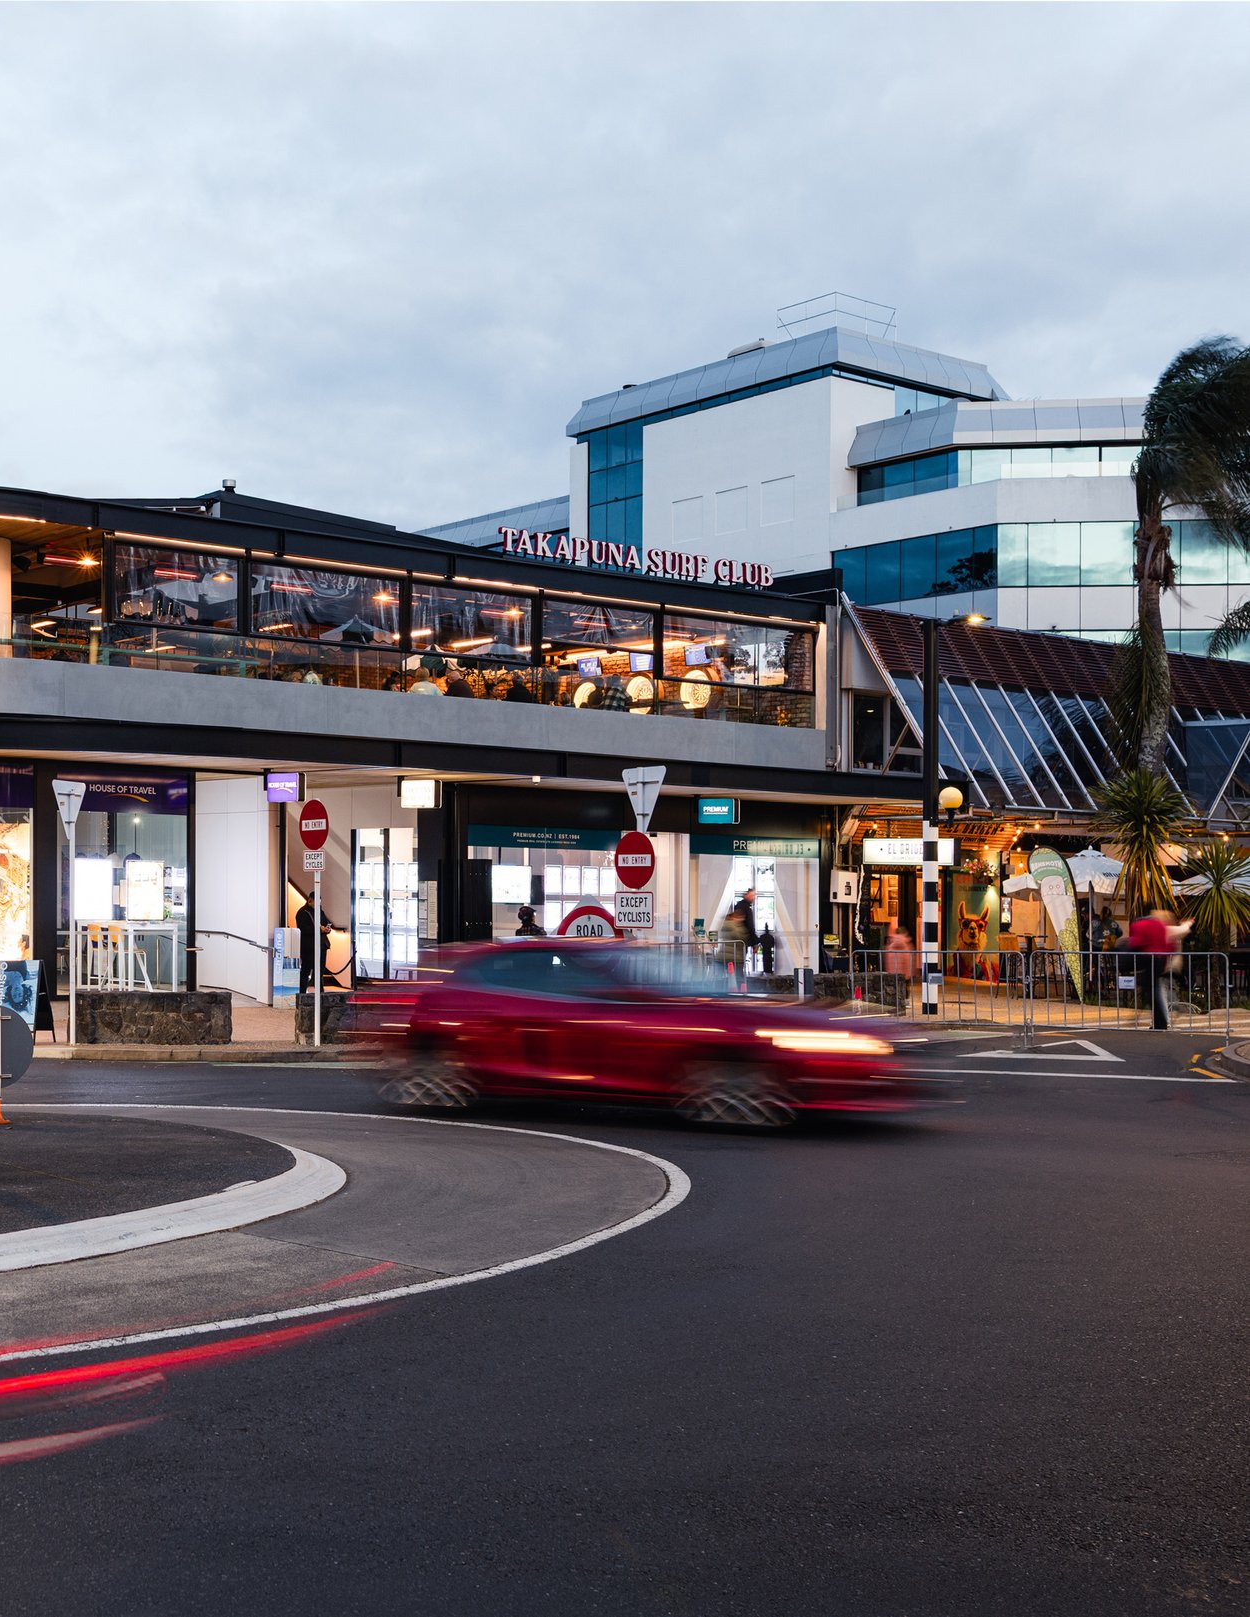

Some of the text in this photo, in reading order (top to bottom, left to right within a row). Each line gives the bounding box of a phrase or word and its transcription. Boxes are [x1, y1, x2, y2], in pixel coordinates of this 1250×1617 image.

[498, 526, 774, 587] TAKAPUNA SURF CLUB
[89, 783, 116, 793] HOUSE
[116, 785, 128, 793] OF
[129, 785, 157, 795] TRAVEL
[304, 820, 324, 829] NO ENTRY
[887, 842, 923, 855] EL ORIGE
[305, 852, 323, 861] EXCEPT
[621, 856, 647, 865] NO ENTRY
[305, 861, 323, 869] CYCLES
[620, 896, 648, 908] EXCEPT
[617, 911, 651, 923] CYCLISTS
[576, 924, 604, 937] ROAD
